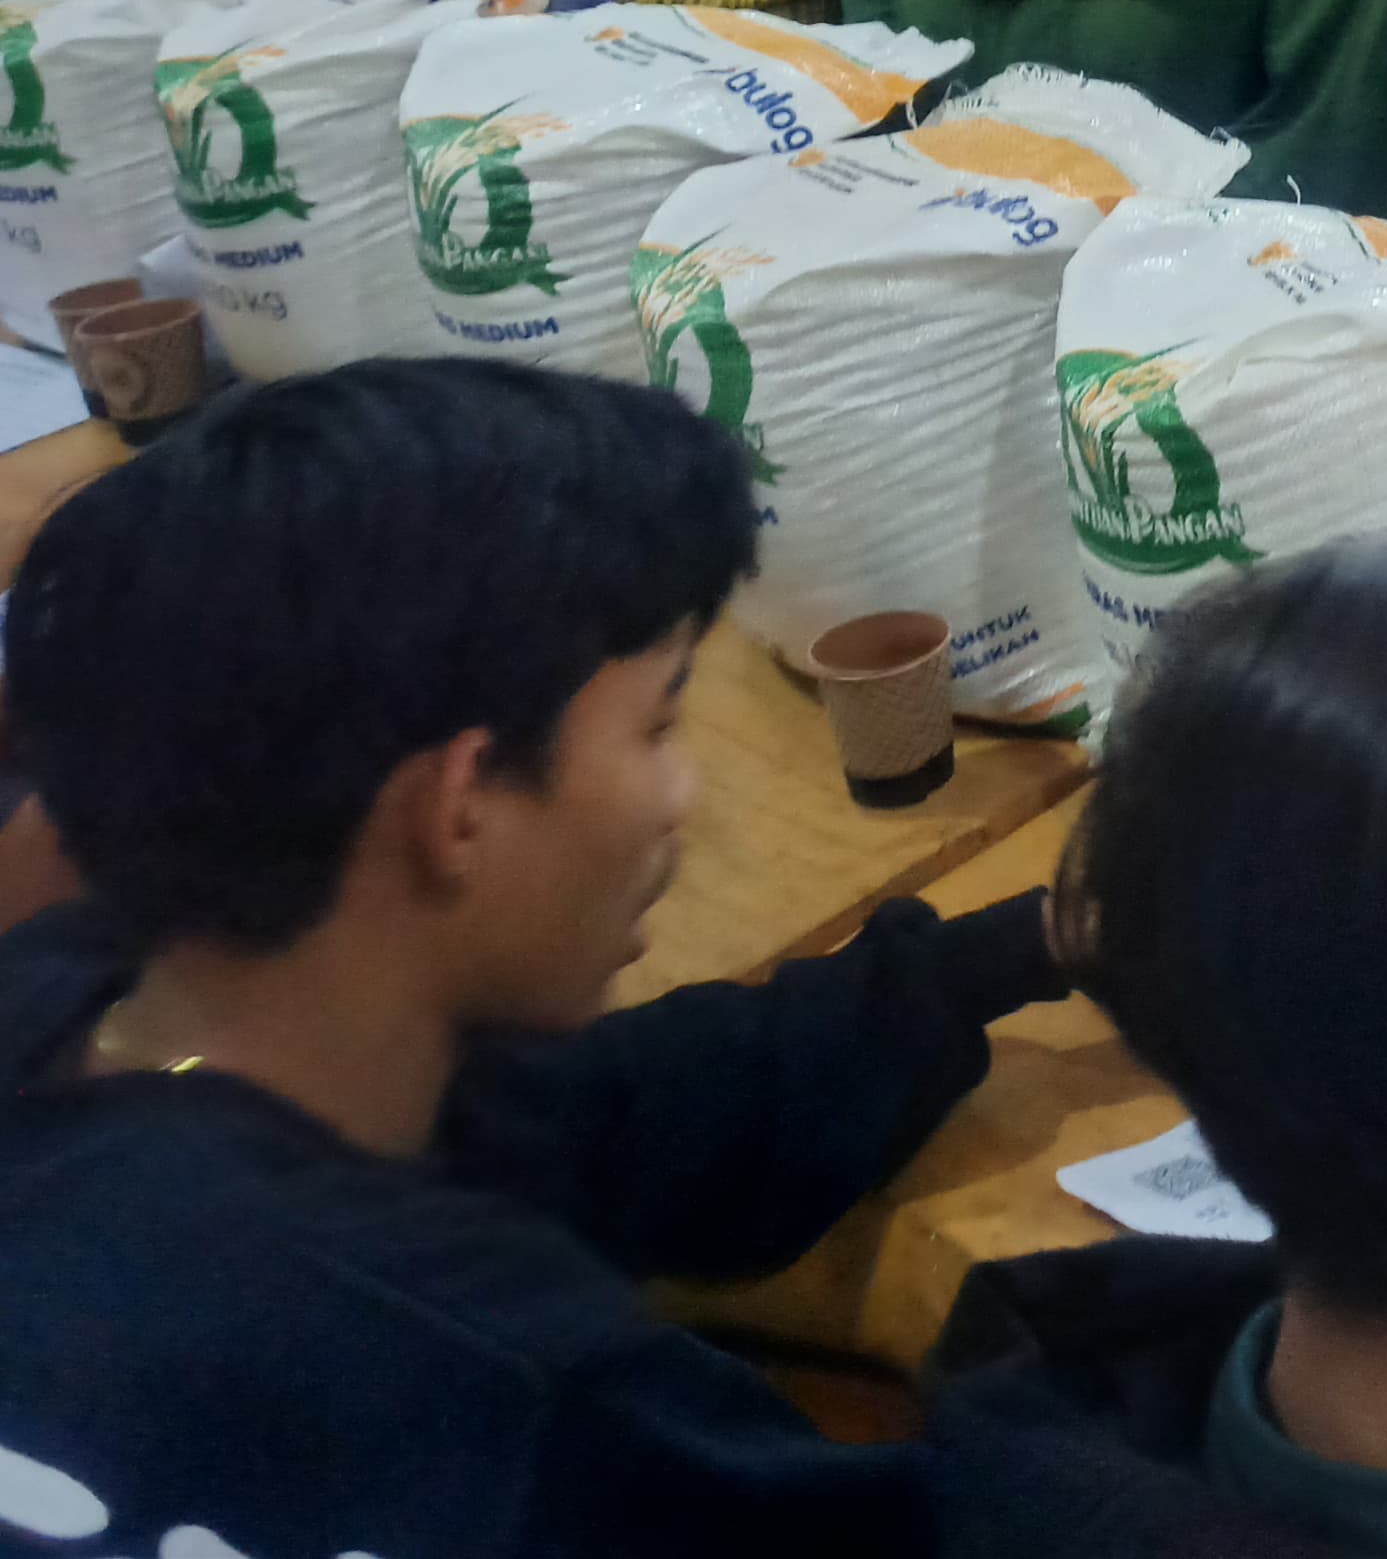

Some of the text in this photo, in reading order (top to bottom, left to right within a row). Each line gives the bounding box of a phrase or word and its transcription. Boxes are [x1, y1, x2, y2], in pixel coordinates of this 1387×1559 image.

[722, 67, 815, 156] bulog
[459, 316, 560, 343] MEDIUM
[1123, 494, 1246, 546] PANGAN
